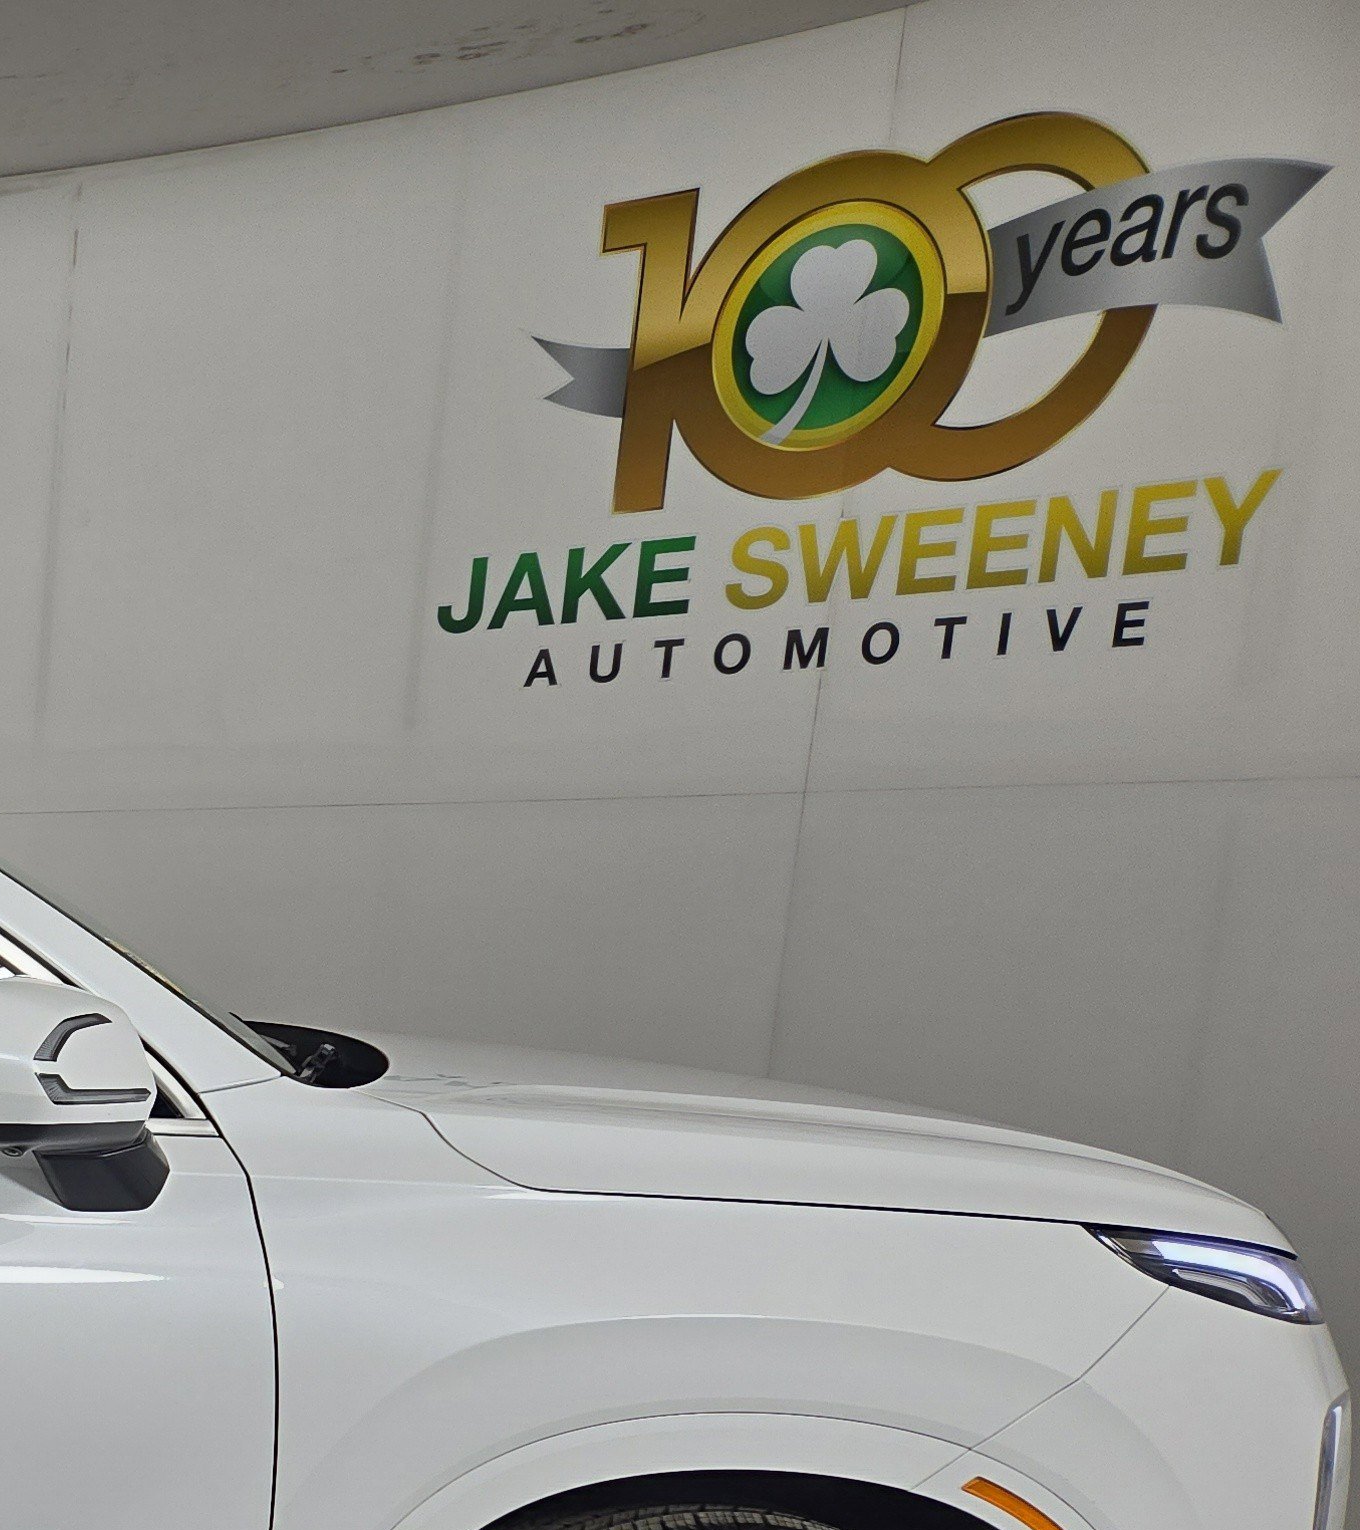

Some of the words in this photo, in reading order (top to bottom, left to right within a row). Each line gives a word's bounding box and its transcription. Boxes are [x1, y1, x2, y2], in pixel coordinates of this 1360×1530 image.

[600, 110, 1159, 514] 100
[1005, 181, 1250, 317] years
[437, 536, 698, 635] JAKE
[724, 468, 1282, 611] SWEENEY
[524, 600, 1152, 688] AUTOMOTIVE
